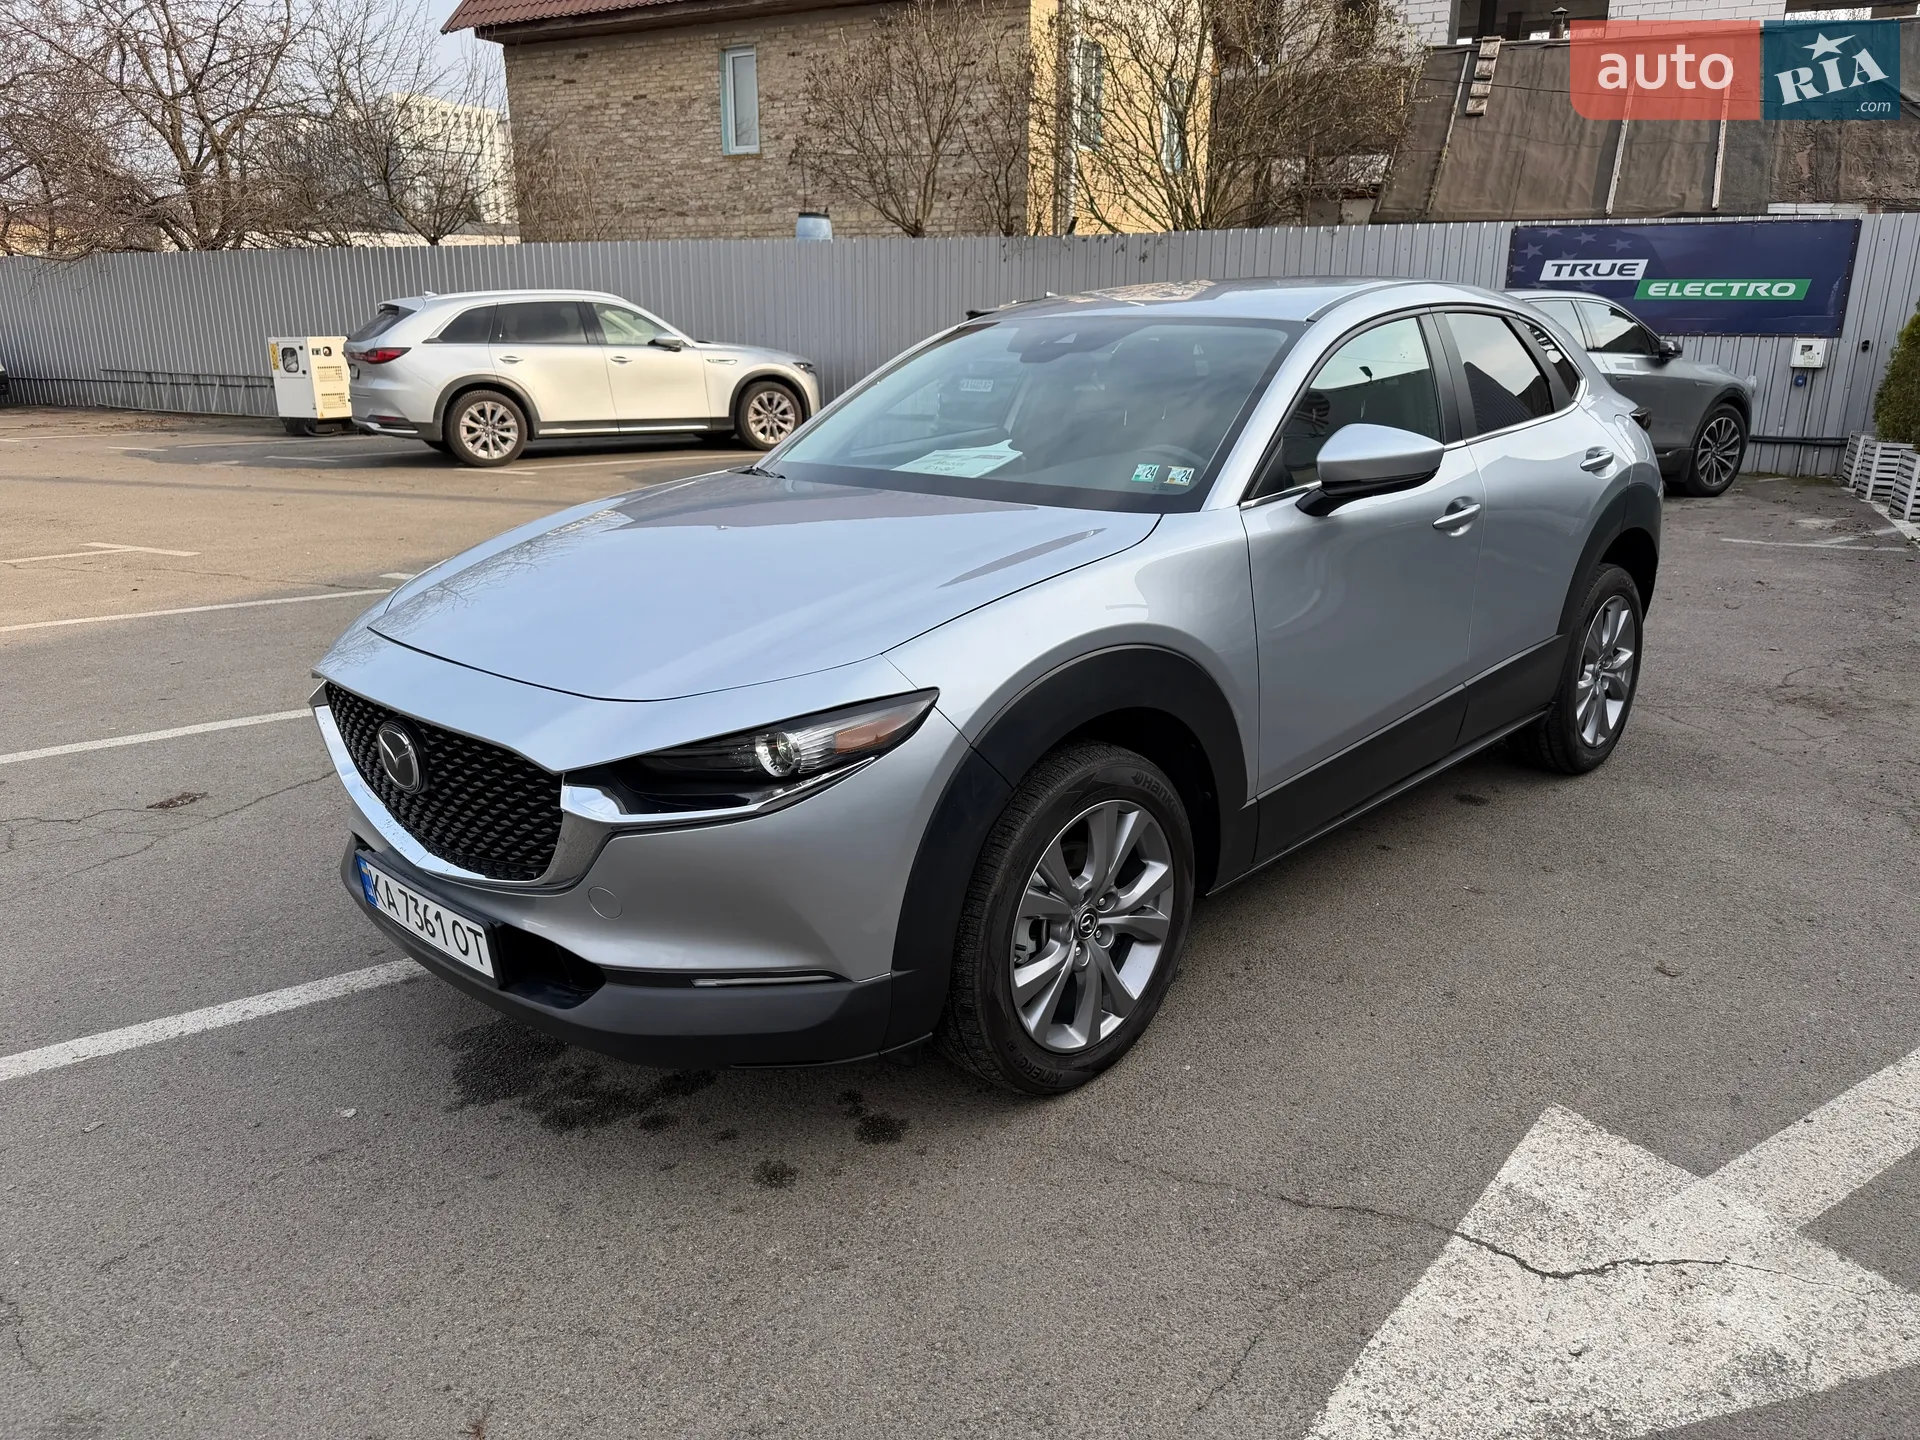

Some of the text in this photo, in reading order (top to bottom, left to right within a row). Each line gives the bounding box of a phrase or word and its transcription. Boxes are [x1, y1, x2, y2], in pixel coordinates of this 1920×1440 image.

[1550, 262, 1640, 278] TRUE
[1647, 281, 1797, 298] ELECTRO
[1145, 466, 1157, 479] 24
[1180, 469, 1192, 482] 24
[368, 869, 484, 965] KA 7361 OT
